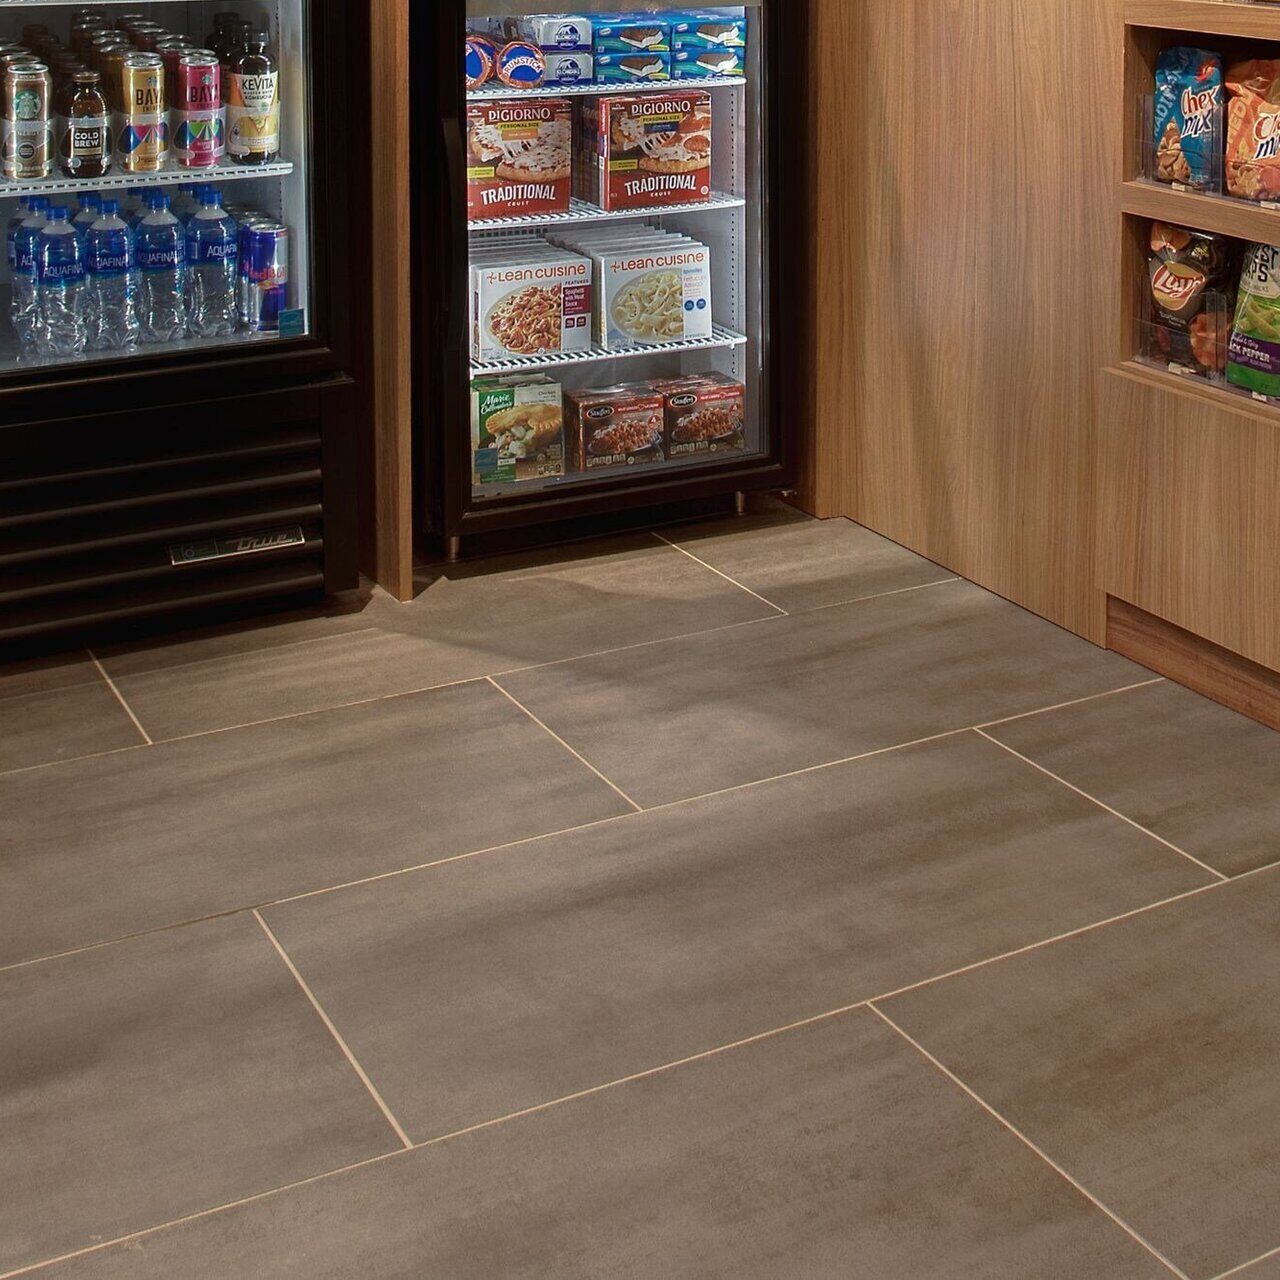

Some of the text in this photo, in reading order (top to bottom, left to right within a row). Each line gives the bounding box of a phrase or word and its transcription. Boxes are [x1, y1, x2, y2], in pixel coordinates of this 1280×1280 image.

[241, 76, 274, 91] KEVITA
[1181, 85, 1220, 116] Chex
[74, 131, 99, 140] COLD
[74, 139, 99, 148] BREW
[624, 174, 698, 197] TRADITIONAL
[480, 183, 557, 206] TRADITIONAL
[43, 262, 84, 278] AQUAFINA
[564, 278, 590, 286] FEATURES
[1154, 271, 1201, 298] Lay's
[1242, 346, 1270, 363] PEPPER
